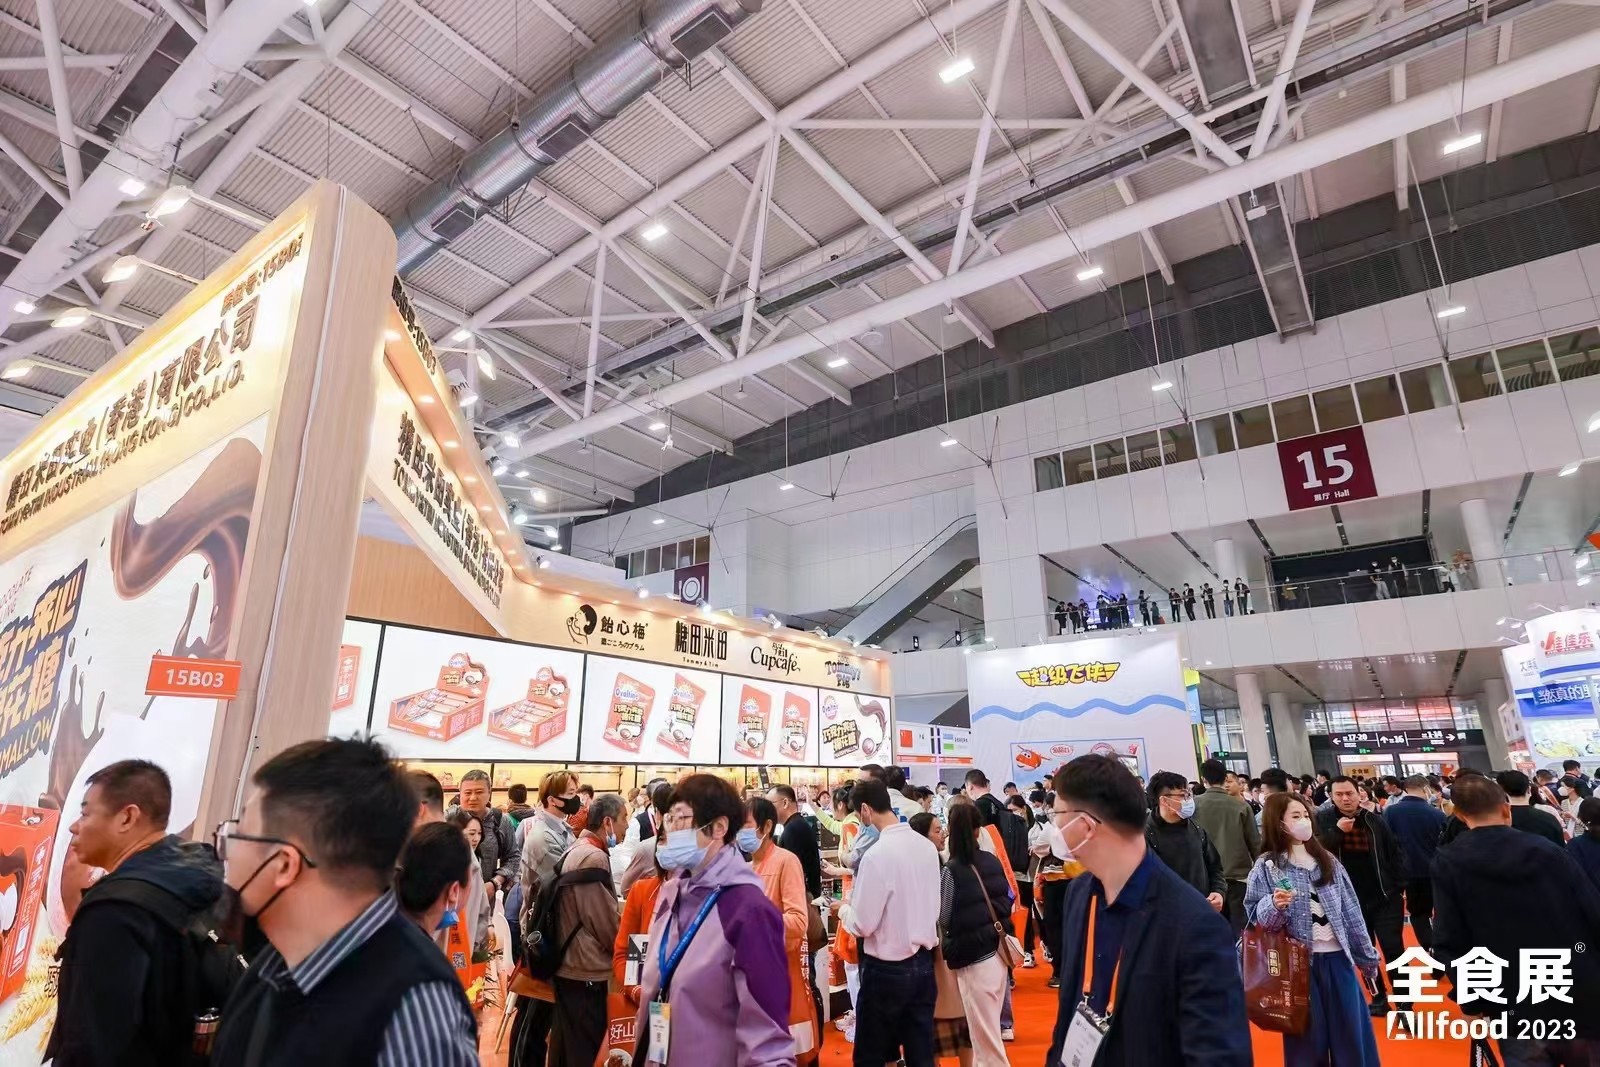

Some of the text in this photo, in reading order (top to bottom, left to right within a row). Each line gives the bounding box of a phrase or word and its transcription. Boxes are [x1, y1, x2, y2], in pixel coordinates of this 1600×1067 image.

[1296, 444, 1353, 489] 15
[1334, 488, 1350, 498] Hall
[166, 668, 224, 688] 15B03
[1029, 661, 1109, 687] 超级飞侠
